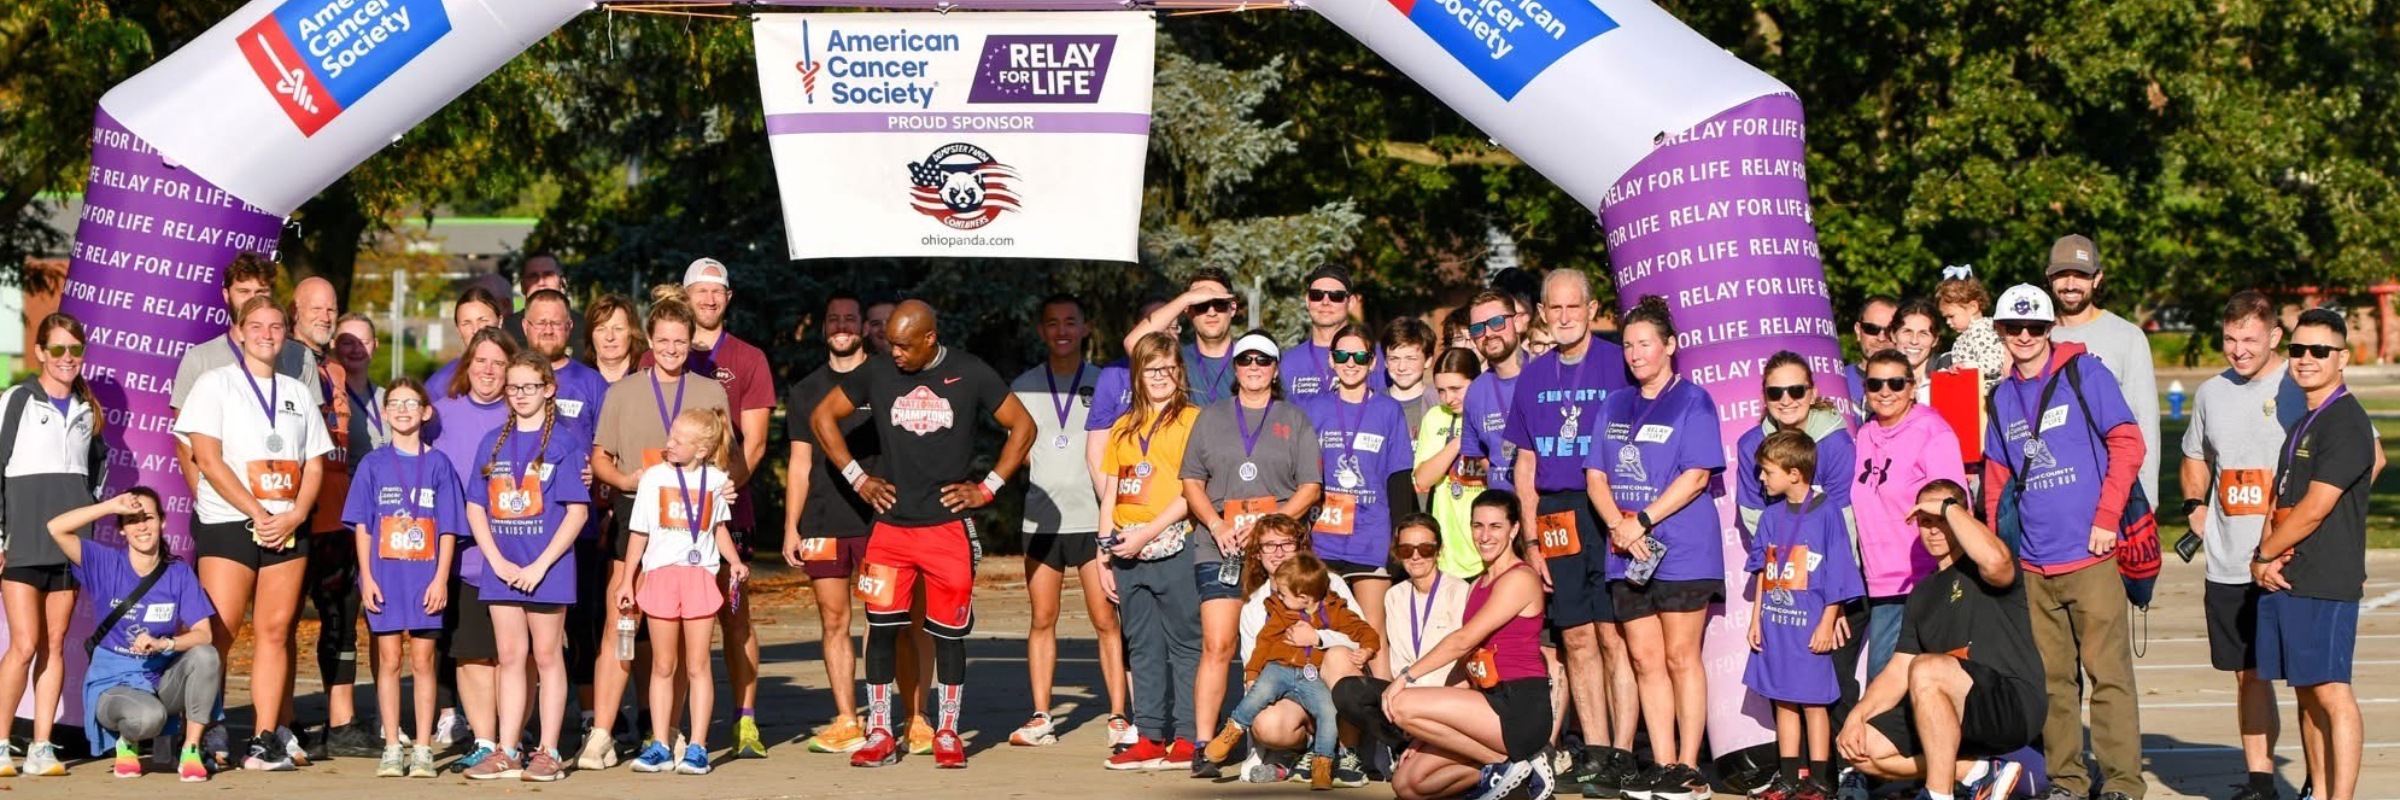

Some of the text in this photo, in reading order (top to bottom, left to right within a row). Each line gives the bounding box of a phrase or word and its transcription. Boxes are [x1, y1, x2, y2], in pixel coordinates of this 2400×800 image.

[309, 0, 389, 58] Cancer
[1511, 0, 1567, 40] ican
[322, 5, 411, 79] Society
[826, 29, 960, 53] American
[827, 56, 929, 78] Cancer
[1009, 43, 1101, 68] RELAY
[831, 81, 934, 109] Society
[999, 71, 1091, 95] FOR LIFE
[888, 116, 1034, 130] PROUD SPONSOR
[1732, 117, 1768, 136] FOR
[1772, 118, 1798, 138] LIFE
[104, 130, 128, 149] FOR
[103, 169, 150, 194] RELAY
[152, 178, 190, 200] FOR
[195, 186, 234, 208] LIFE
[1604, 177, 1643, 208] RELAY
[1648, 167, 1684, 192] FOR
[1690, 160, 1731, 182] LIFE
[1741, 158, 1790, 176] RELAY
[91, 207, 114, 226] FOR
[117, 212, 154, 233] LIFE
[162, 220, 222, 245] RELAY
[225, 231, 254, 251] FOR
[256, 237, 278, 254] LIFE
[1609, 198, 1803, 251] FOR LIFE RELAY FOR LIFE
[921, 234, 1015, 248] ohiopanda.com
[85, 245, 131, 269] RELAY
[134, 255, 172, 277] FOR
[175, 262, 215, 284] LIFE
[1618, 258, 1652, 287] RELAY
[1657, 248, 1693, 273] FOR
[1697, 240, 1739, 263] LIFE
[1749, 238, 1800, 256] RELAY
[72, 282, 97, 302] FOR
[98, 288, 135, 310] LIFE
[142, 296, 203, 321] RELAY
[1679, 280, 1741, 309] RELAY
[1746, 278, 1783, 297] FOR
[1786, 277, 1816, 296] LIFE
[84, 323, 112, 345] LAY
[115, 331, 152, 352] FOR
[1678, 317, 1834, 351] OR LIFE RELAY FOR
[81, 363, 174, 396] LIFE RELA
[1691, 359, 1752, 385] RELAY
[1808, 355, 1831, 375] IFE
[891, 408, 953, 425] CHAMPIONS
[898, 400, 944, 408] NATIONAL
[1720, 399, 1761, 423] LIFE
[100, 406, 177, 434] FOR LIFE
[1535, 435, 1592, 457] VET
[107, 448, 167, 474] RELAY
[260, 473, 293, 491] 824
[166, 496, 194, 514] REL
[498, 491, 532, 510] 84
[2227, 485, 2263, 505] 849
[1310, 505, 1343, 525] 843
[1543, 528, 1568, 548] 818
[858, 574, 886, 596] 857
